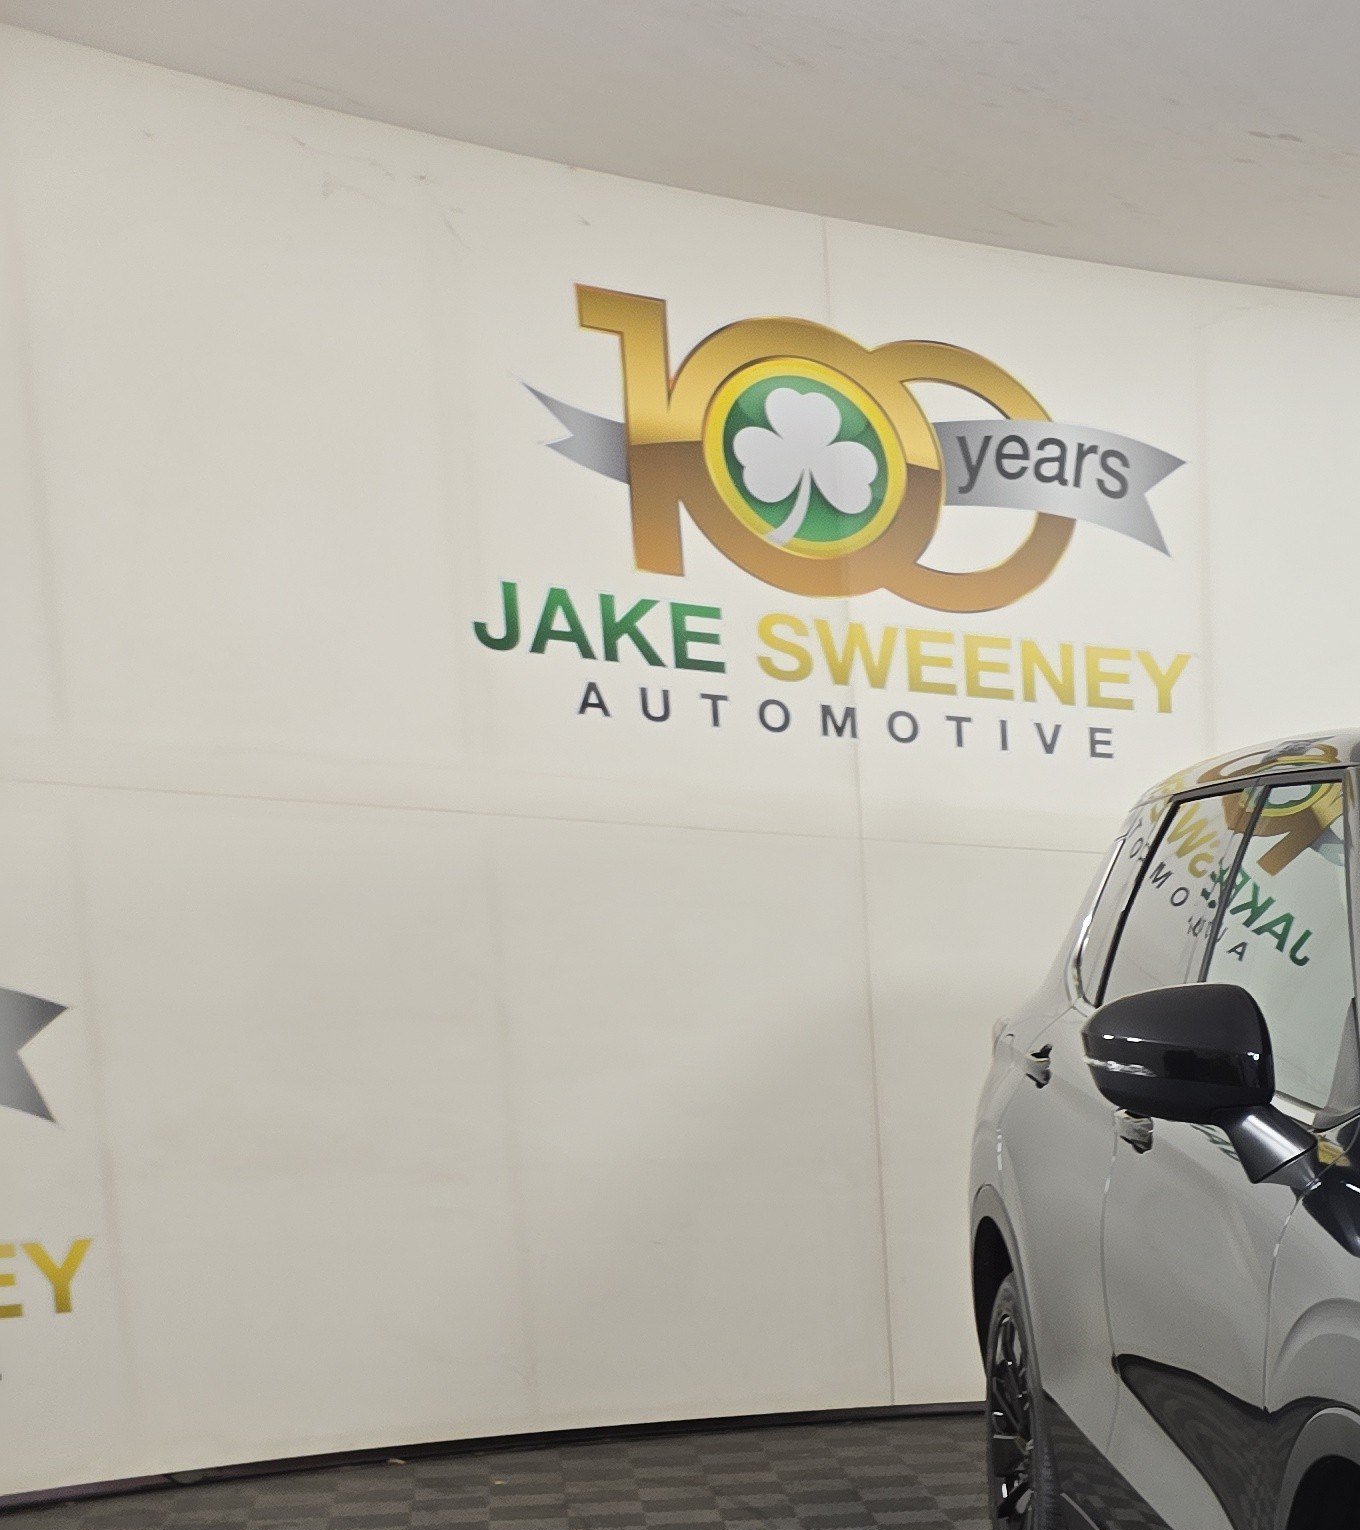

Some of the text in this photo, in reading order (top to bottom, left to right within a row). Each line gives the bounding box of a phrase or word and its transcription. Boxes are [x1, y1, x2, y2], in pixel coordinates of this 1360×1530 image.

[573, 283, 1079, 614] 100
[955, 435, 1131, 500] years
[473, 581, 1192, 714] JAKE SWEENEY
[578, 681, 1115, 760] AUTOMOTIVE
